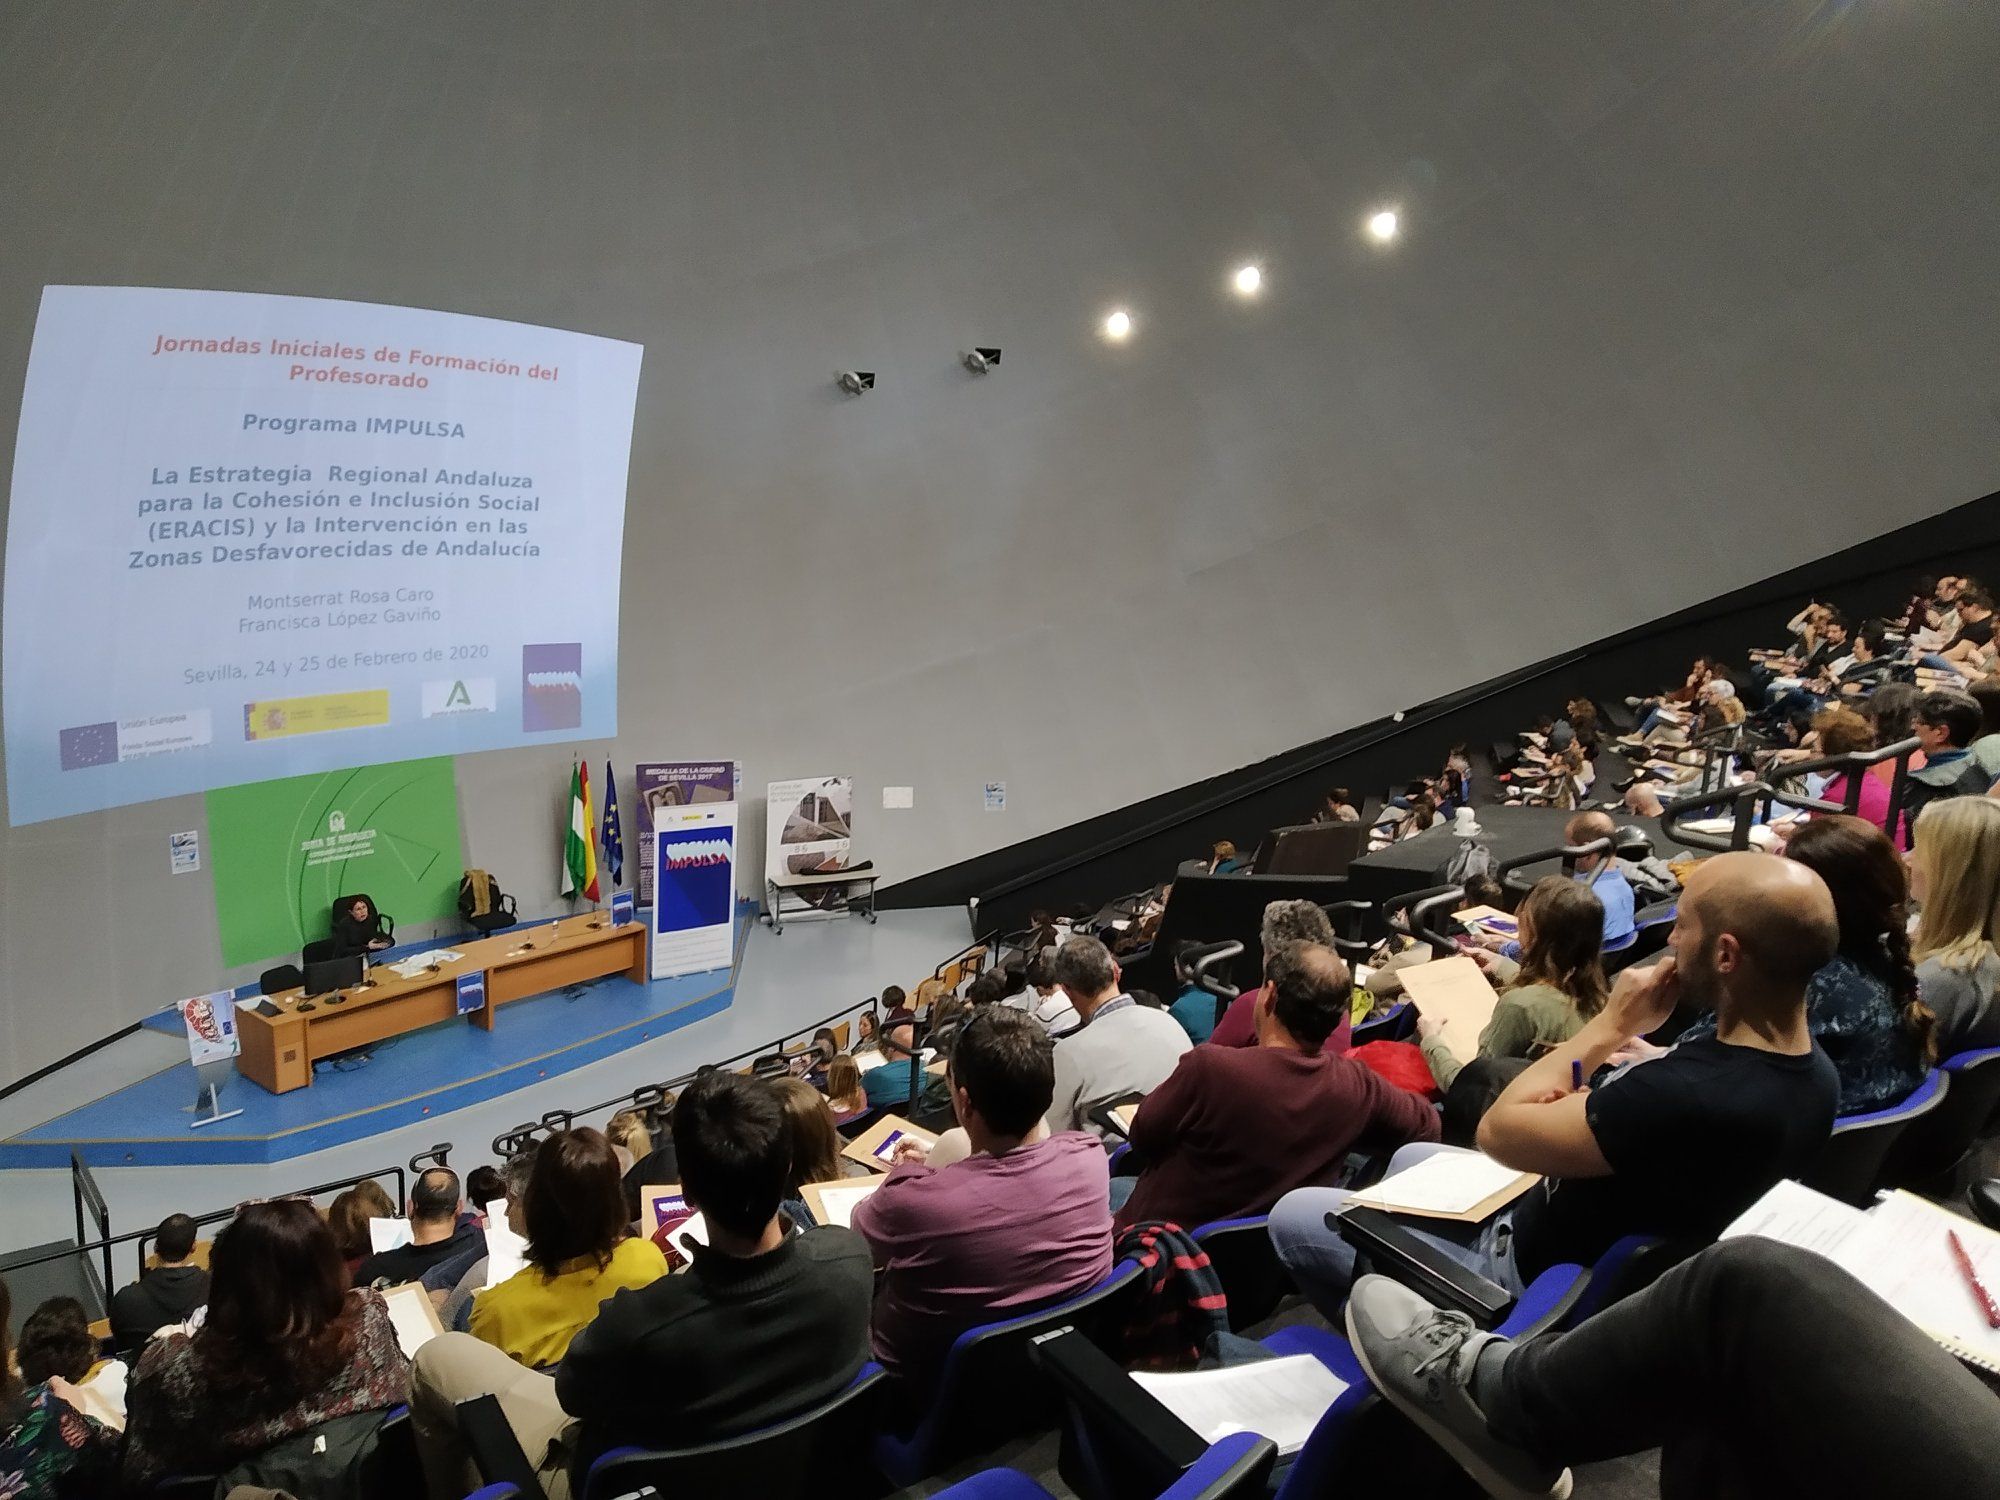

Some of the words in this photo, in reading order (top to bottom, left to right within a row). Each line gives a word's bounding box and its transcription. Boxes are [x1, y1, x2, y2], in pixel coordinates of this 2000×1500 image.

[152, 335, 262, 357] Jornadas
[270, 339, 366, 361] Iniciales
[374, 346, 401, 363] de
[409, 349, 520, 376] Formación
[528, 365, 559, 381] del
[289, 364, 429, 389] Profesorado
[242, 414, 357, 435] Programa
[366, 417, 465, 438] IMPULSA
[152, 468, 178, 485] La
[189, 465, 312, 486] Estrategia
[328, 465, 427, 486] Regional
[435, 469, 533, 489] Andaluza
[138, 497, 193, 517] para
[203, 492, 223, 510] la
[233, 489, 340, 509] Cohesión
[349, 494, 362, 507] e
[370, 491, 470, 509] Inclusión
[478, 494, 540, 511] Social
[148, 517, 255, 542] (ERACIS)
[264, 521, 277, 539] y
[286, 517, 305, 533] la
[315, 516, 457, 533] Intervención
[466, 520, 491, 533] en
[499, 518, 528, 534] las
[128, 550, 203, 569] Zonas
[212, 540, 393, 563] Desfavorecidas
[402, 540, 428, 557] de
[435, 540, 541, 557] Andalucía
[248, 591, 344, 611] Montserrat
[350, 590, 390, 604] Rosa
[396, 588, 434, 602] Caro
[239, 615, 320, 633] Francisca
[328, 611, 377, 628] López
[384, 607, 441, 623] Gaviño
[184, 664, 247, 685] Sevilla,
[255, 660, 276, 677] 24
[282, 660, 294, 677] y
[299, 656, 320, 673] 25
[326, 654, 348, 669] de
[354, 650, 418, 667] Febrero
[422, 646, 443, 662] de
[449, 644, 490, 660] 2020
[645, 767, 678, 775] MEDALLA
[666, 853, 727, 871] IMPULSA
